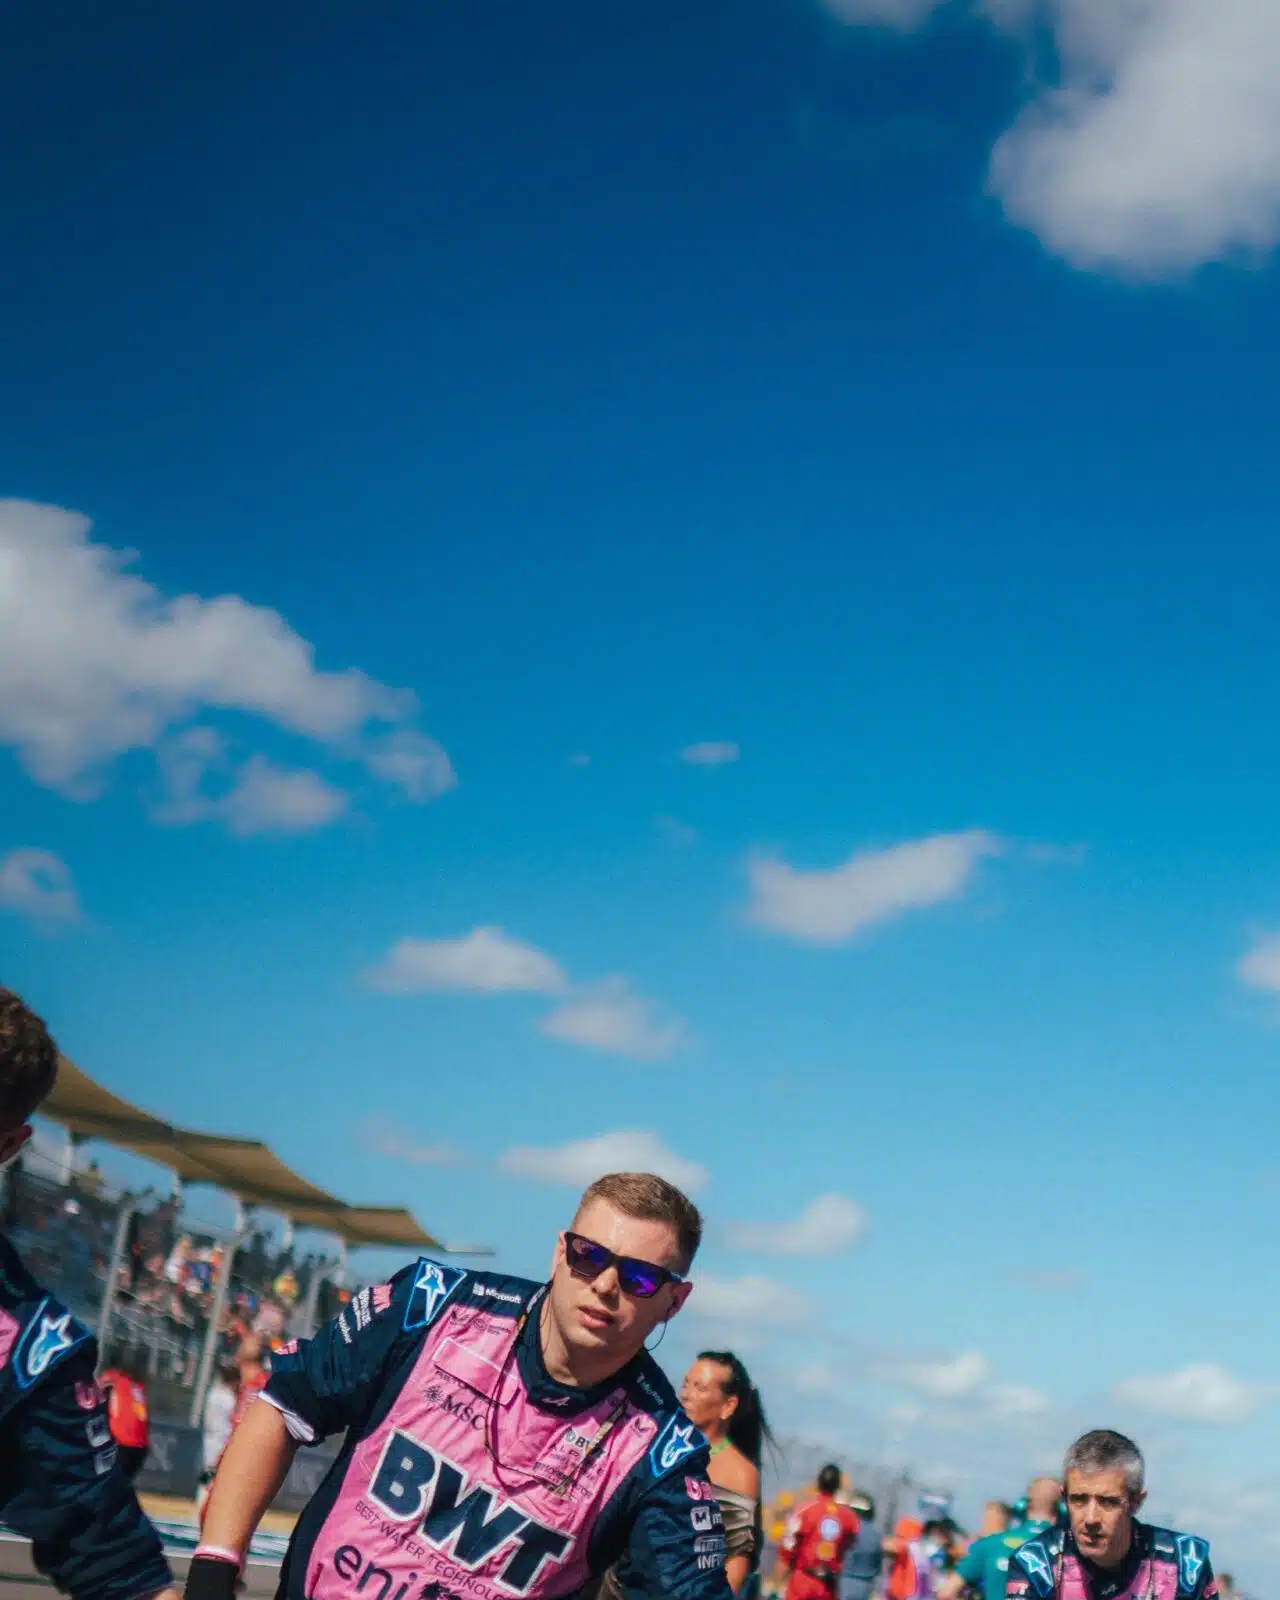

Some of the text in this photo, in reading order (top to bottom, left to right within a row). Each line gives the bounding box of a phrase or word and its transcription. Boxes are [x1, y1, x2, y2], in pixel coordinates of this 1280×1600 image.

[440, 1393, 486, 1431] MSC
[354, 1500, 381, 1526] BEST
[379, 1523, 425, 1560] WATER
[367, 1427, 577, 1597] BWT
